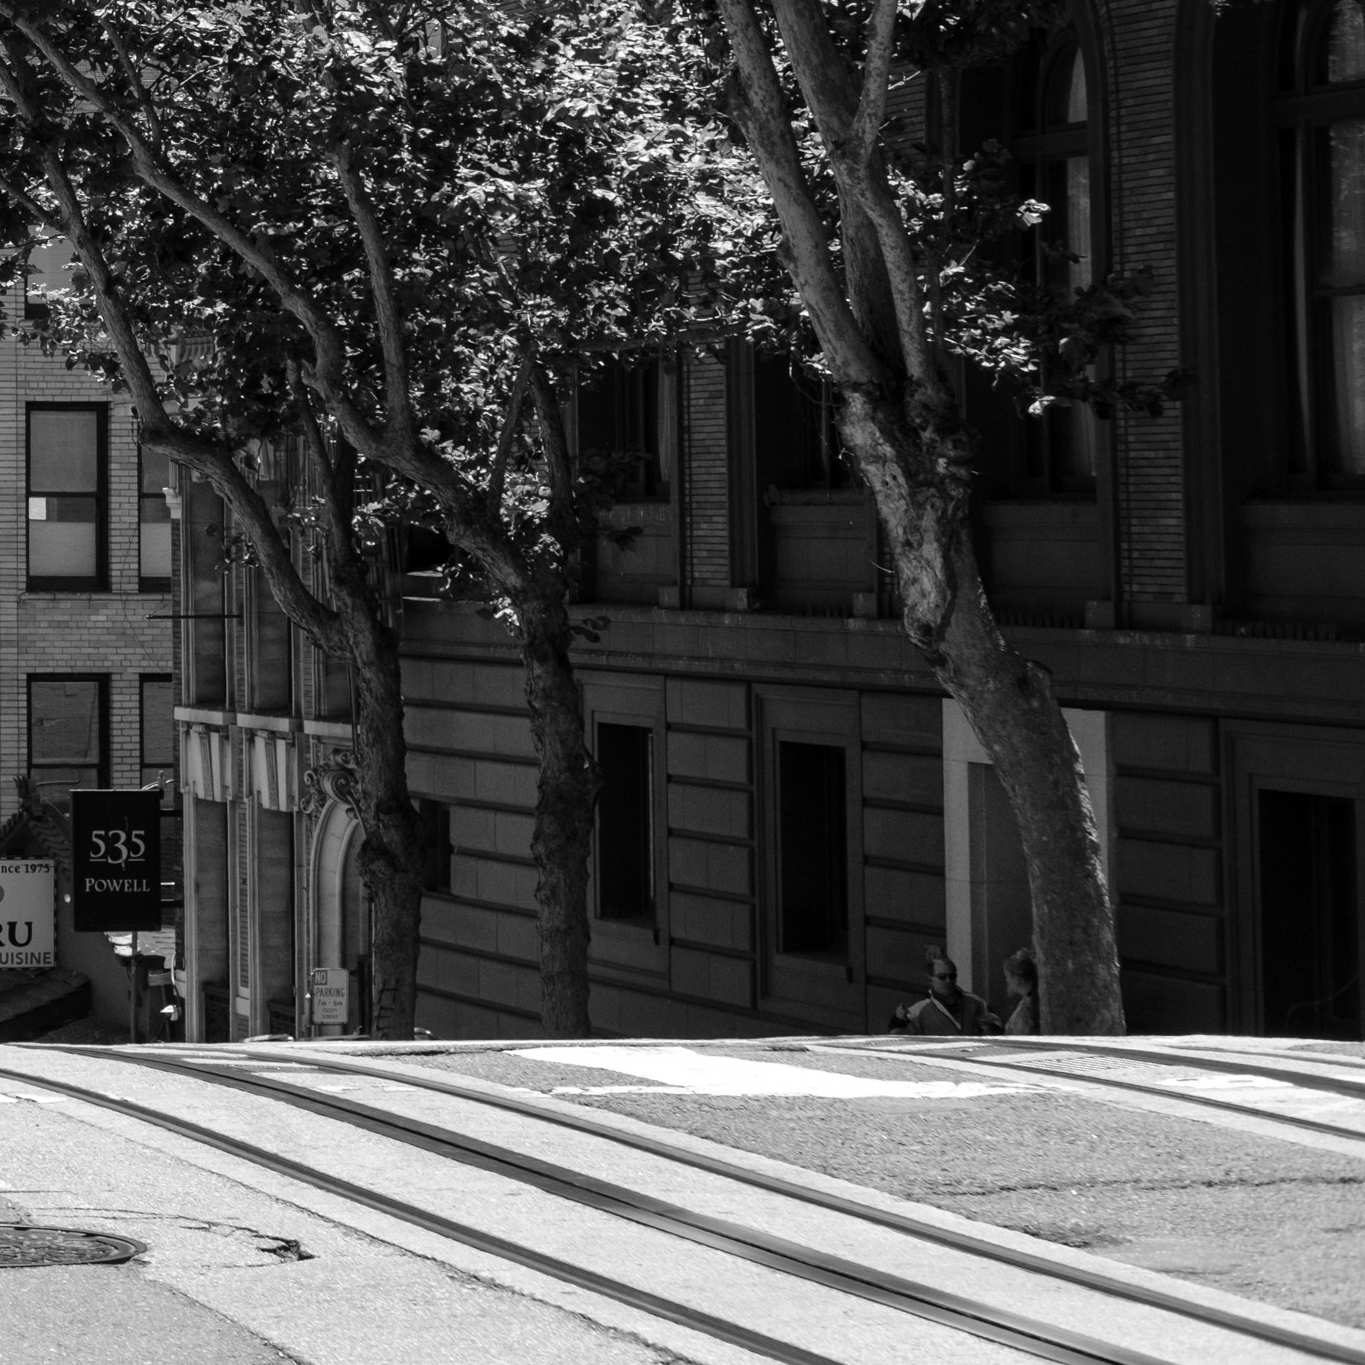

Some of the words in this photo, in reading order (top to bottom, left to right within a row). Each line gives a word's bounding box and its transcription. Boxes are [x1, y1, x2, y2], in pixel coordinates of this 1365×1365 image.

[89, 829, 146, 867] 535
[24, 863, 51, 874] 1975
[315, 971, 327, 984] NO
[315, 987, 345, 998] PARKING
